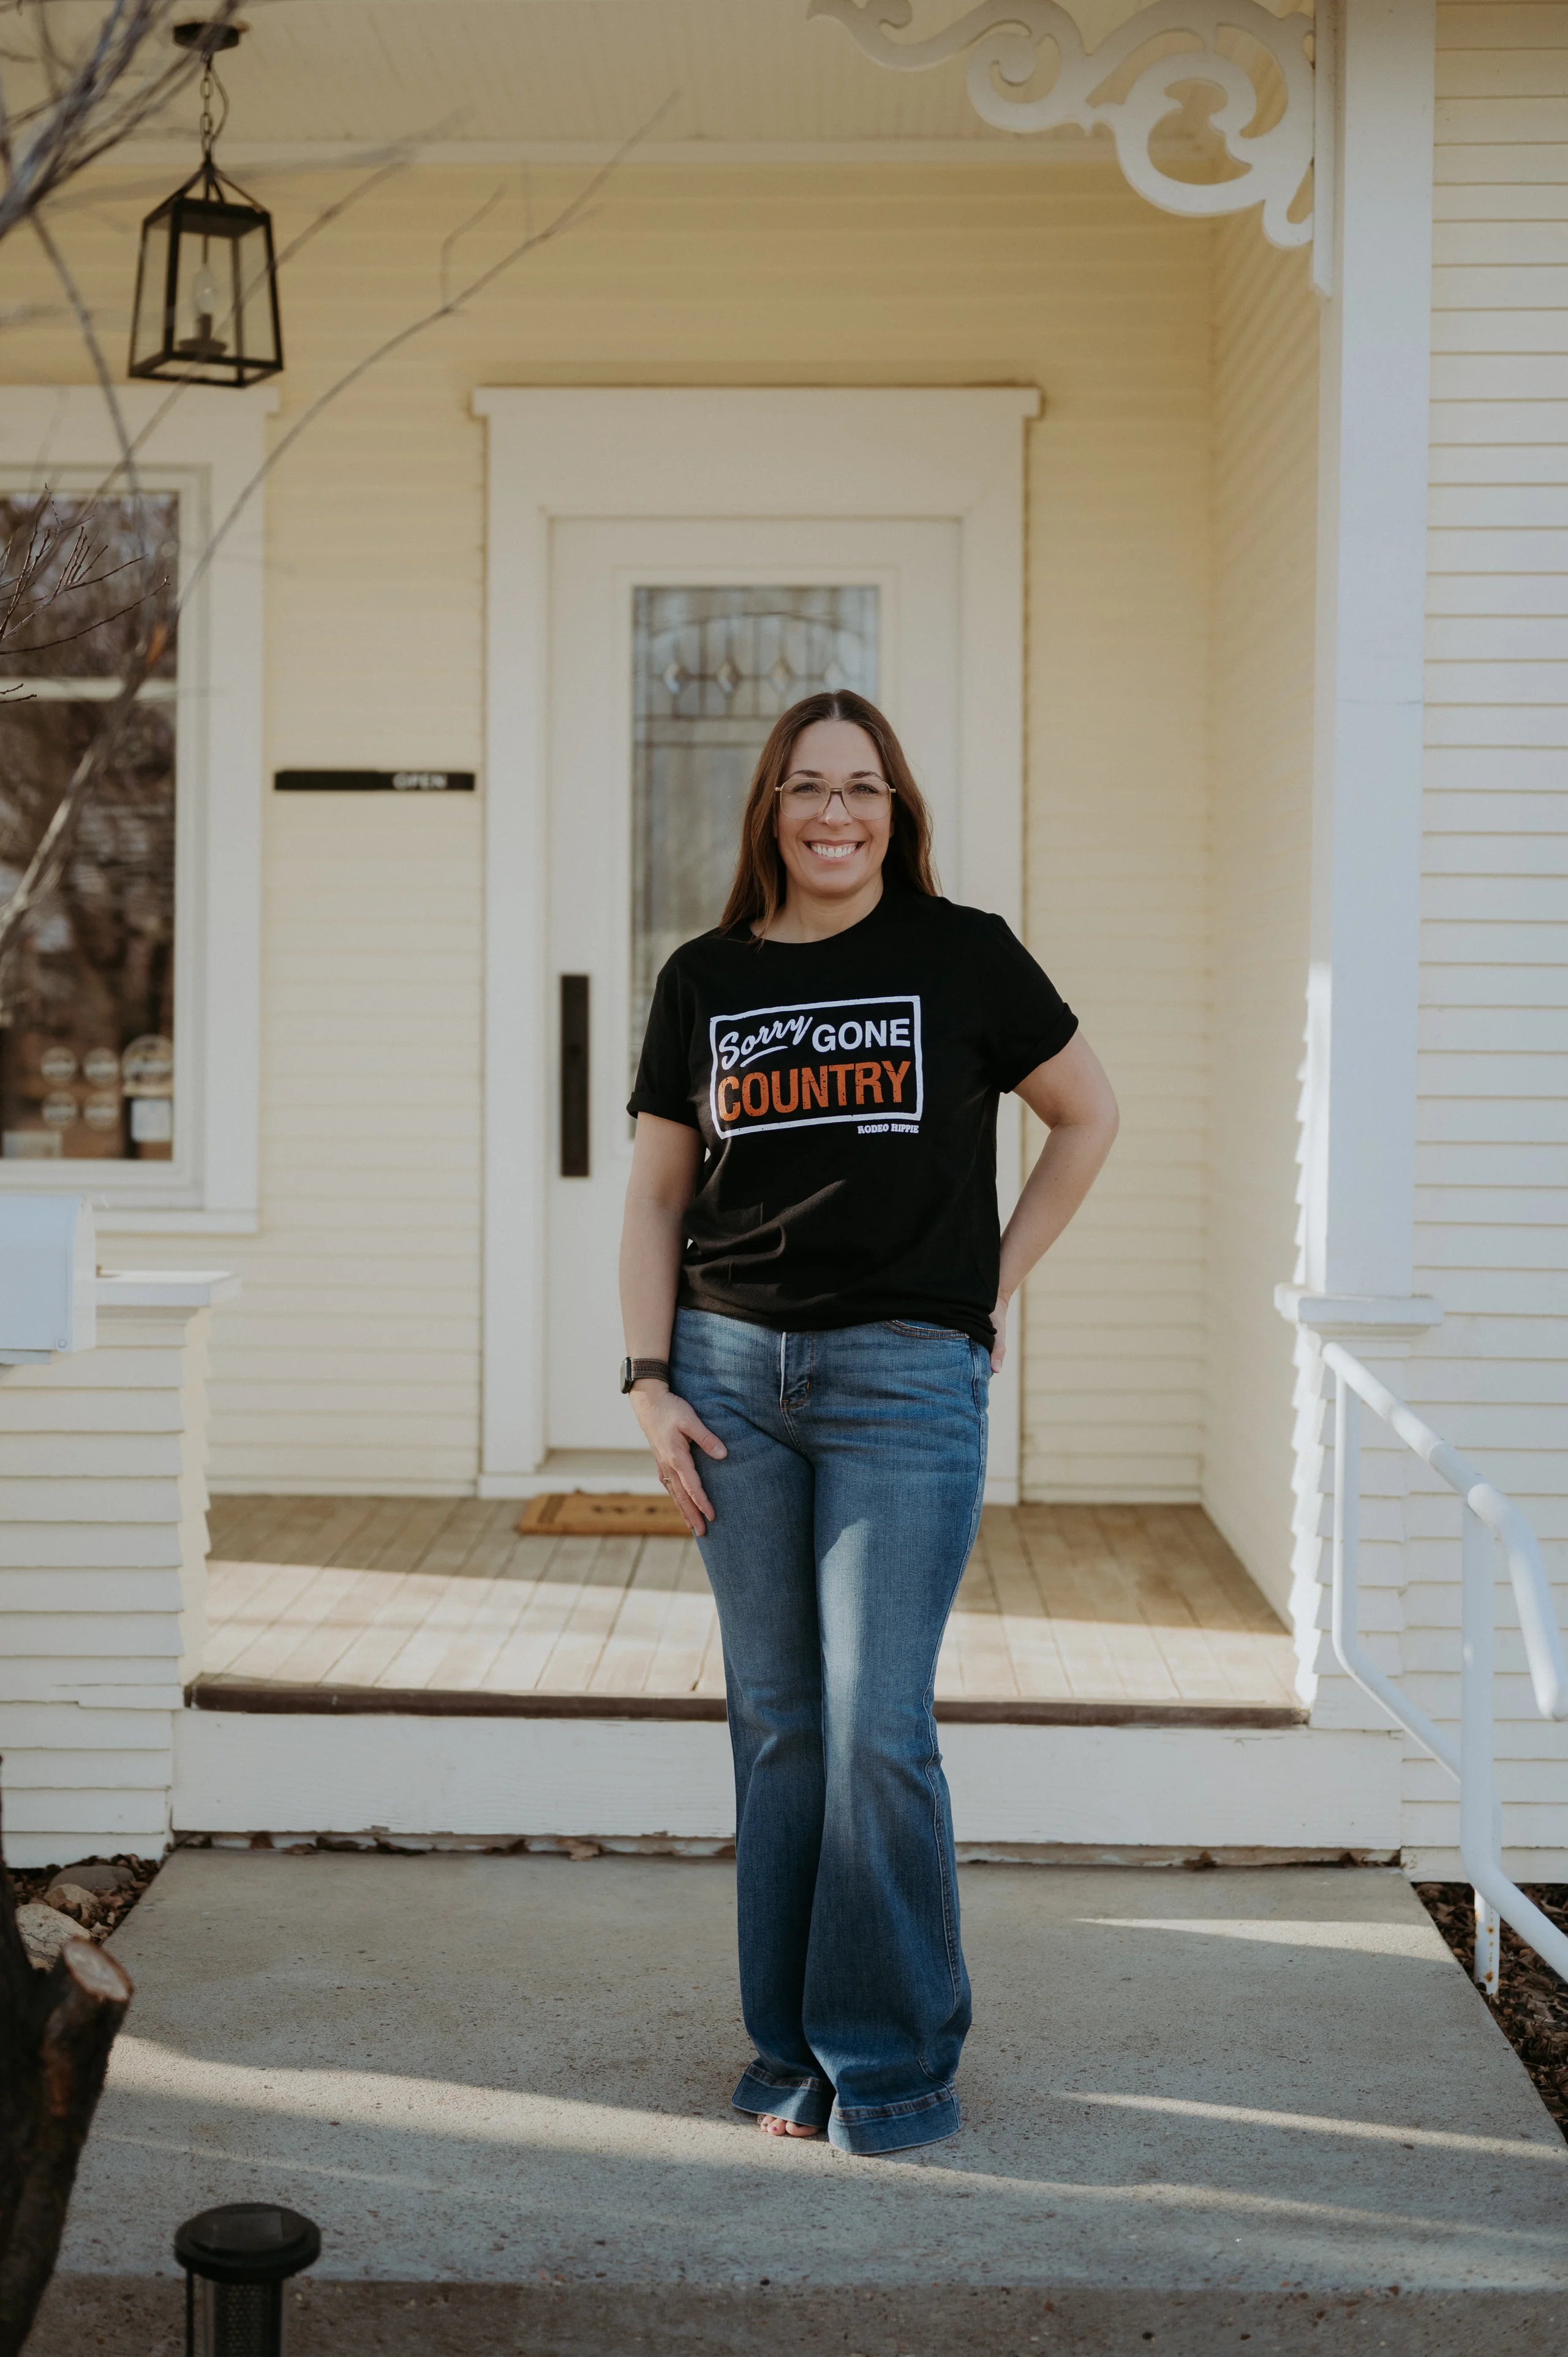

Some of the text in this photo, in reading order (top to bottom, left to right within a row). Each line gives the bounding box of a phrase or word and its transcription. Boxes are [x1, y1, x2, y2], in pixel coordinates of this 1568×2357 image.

[393, 772, 448, 790] OPEN
[718, 1016, 911, 1070] Sorry GONE
[718, 1061, 911, 1122] COUNTRY
[858, 1124, 919, 1134] RODEO HIPPIE
